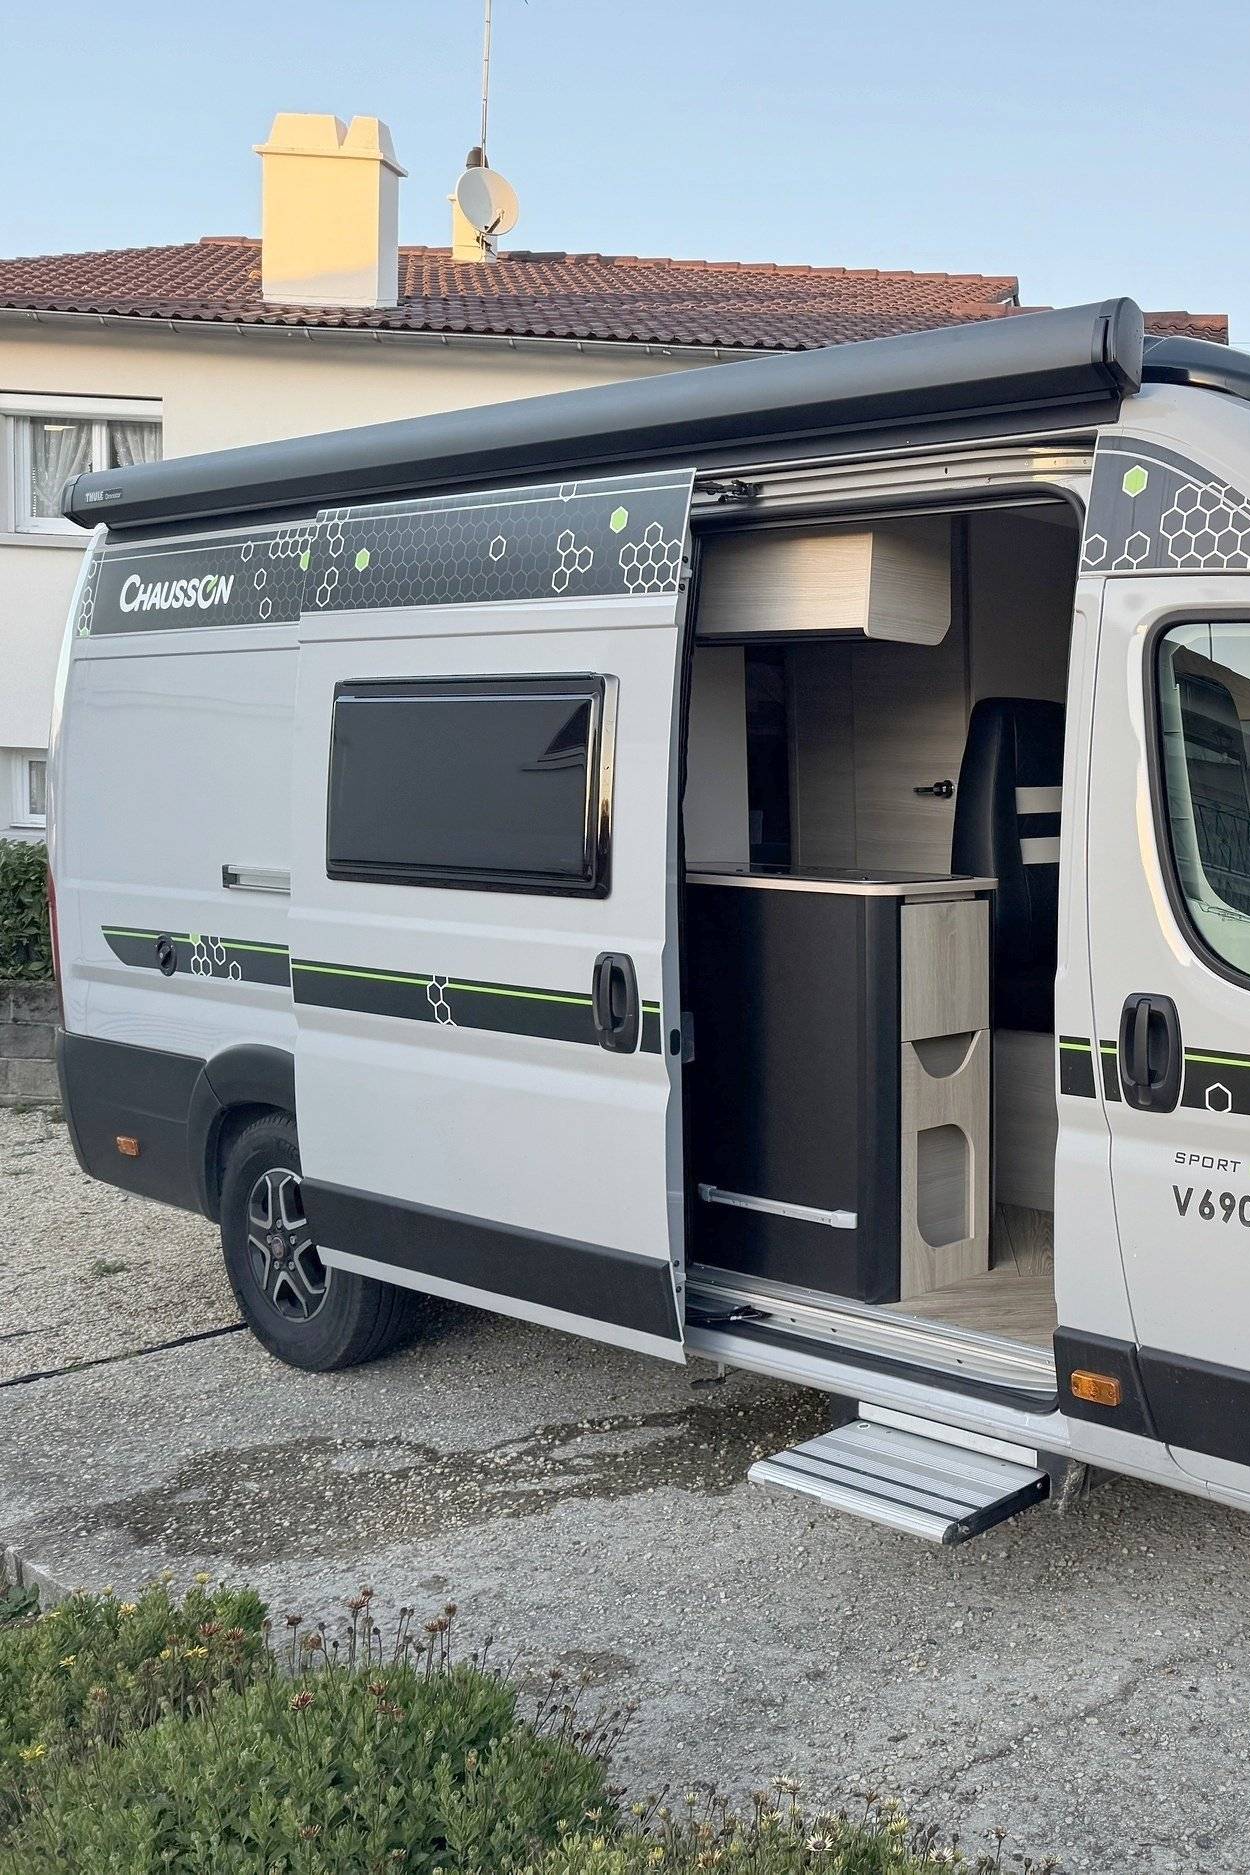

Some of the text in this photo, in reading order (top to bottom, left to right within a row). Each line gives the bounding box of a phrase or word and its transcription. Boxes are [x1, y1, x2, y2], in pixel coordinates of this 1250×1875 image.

[85, 491, 104, 503] THULE
[119, 573, 235, 613] CHAUSSON
[1174, 1151, 1242, 1173] SPORT
